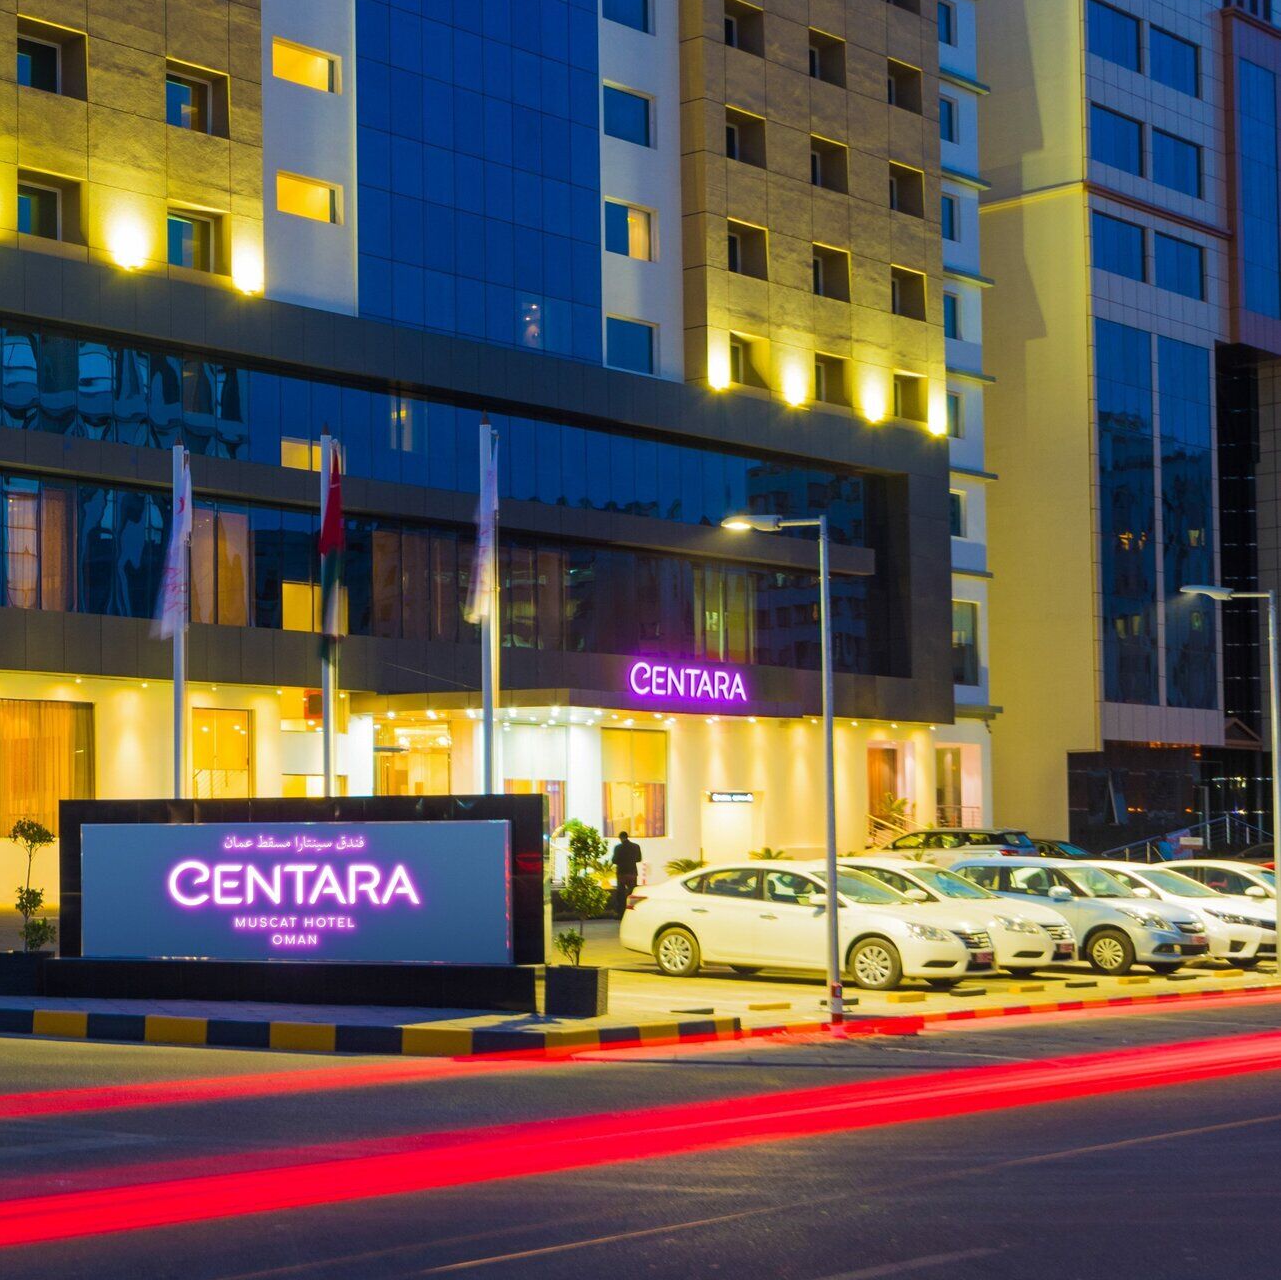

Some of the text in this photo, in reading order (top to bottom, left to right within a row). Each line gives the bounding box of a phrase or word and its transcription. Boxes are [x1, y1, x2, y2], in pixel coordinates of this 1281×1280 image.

[629, 661, 748, 702] CENTARA
[224, 835, 365, 852] فندق سينتارا مسقط عمان
[168, 860, 420, 907] CENTARA
[235, 917, 356, 928] MUSCAT HOTEL
[272, 934, 318, 945] OMAN
